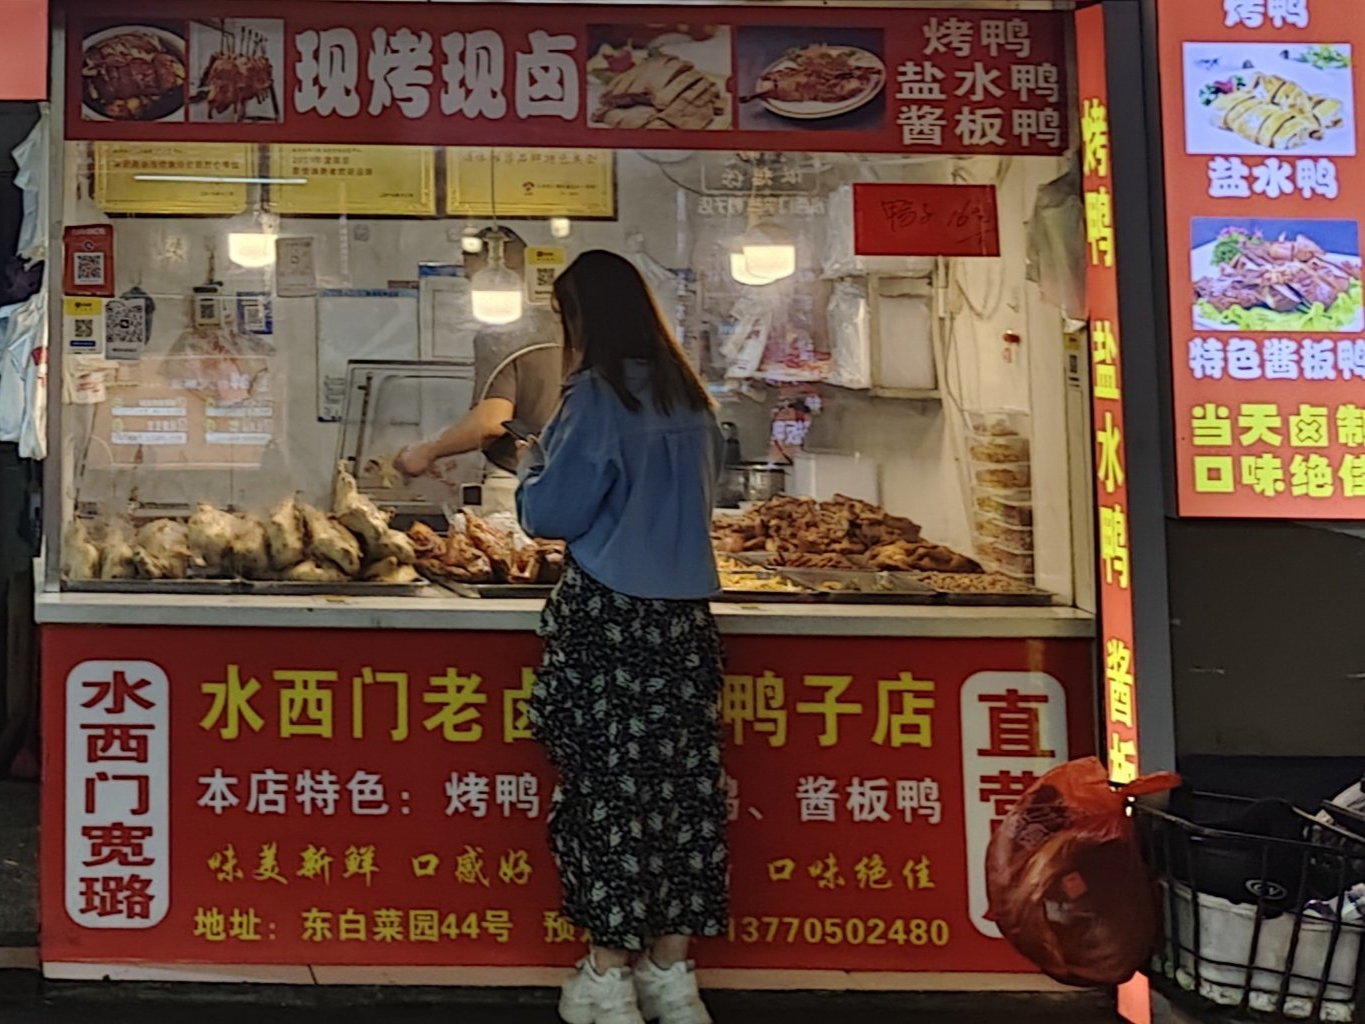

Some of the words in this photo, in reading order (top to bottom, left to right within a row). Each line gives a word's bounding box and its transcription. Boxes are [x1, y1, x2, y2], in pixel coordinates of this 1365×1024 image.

[922, 17, 1032, 58] 烤鸭
[293, 27, 580, 121] 现烤现卤
[895, 61, 1059, 104] 盐水鸭
[896, 105, 1061, 149] 酱板鸭
[1207, 156, 1339, 200] 盐水鸭
[1187, 336, 1365, 381] 特色酱板鸭
[1190, 402, 1365, 447] 当天卤制
[1193, 452, 1365, 499] 口味绝佳
[78, 670, 157, 921] 水西门宽璐
[767, 853, 937, 891] 口味绝佳
